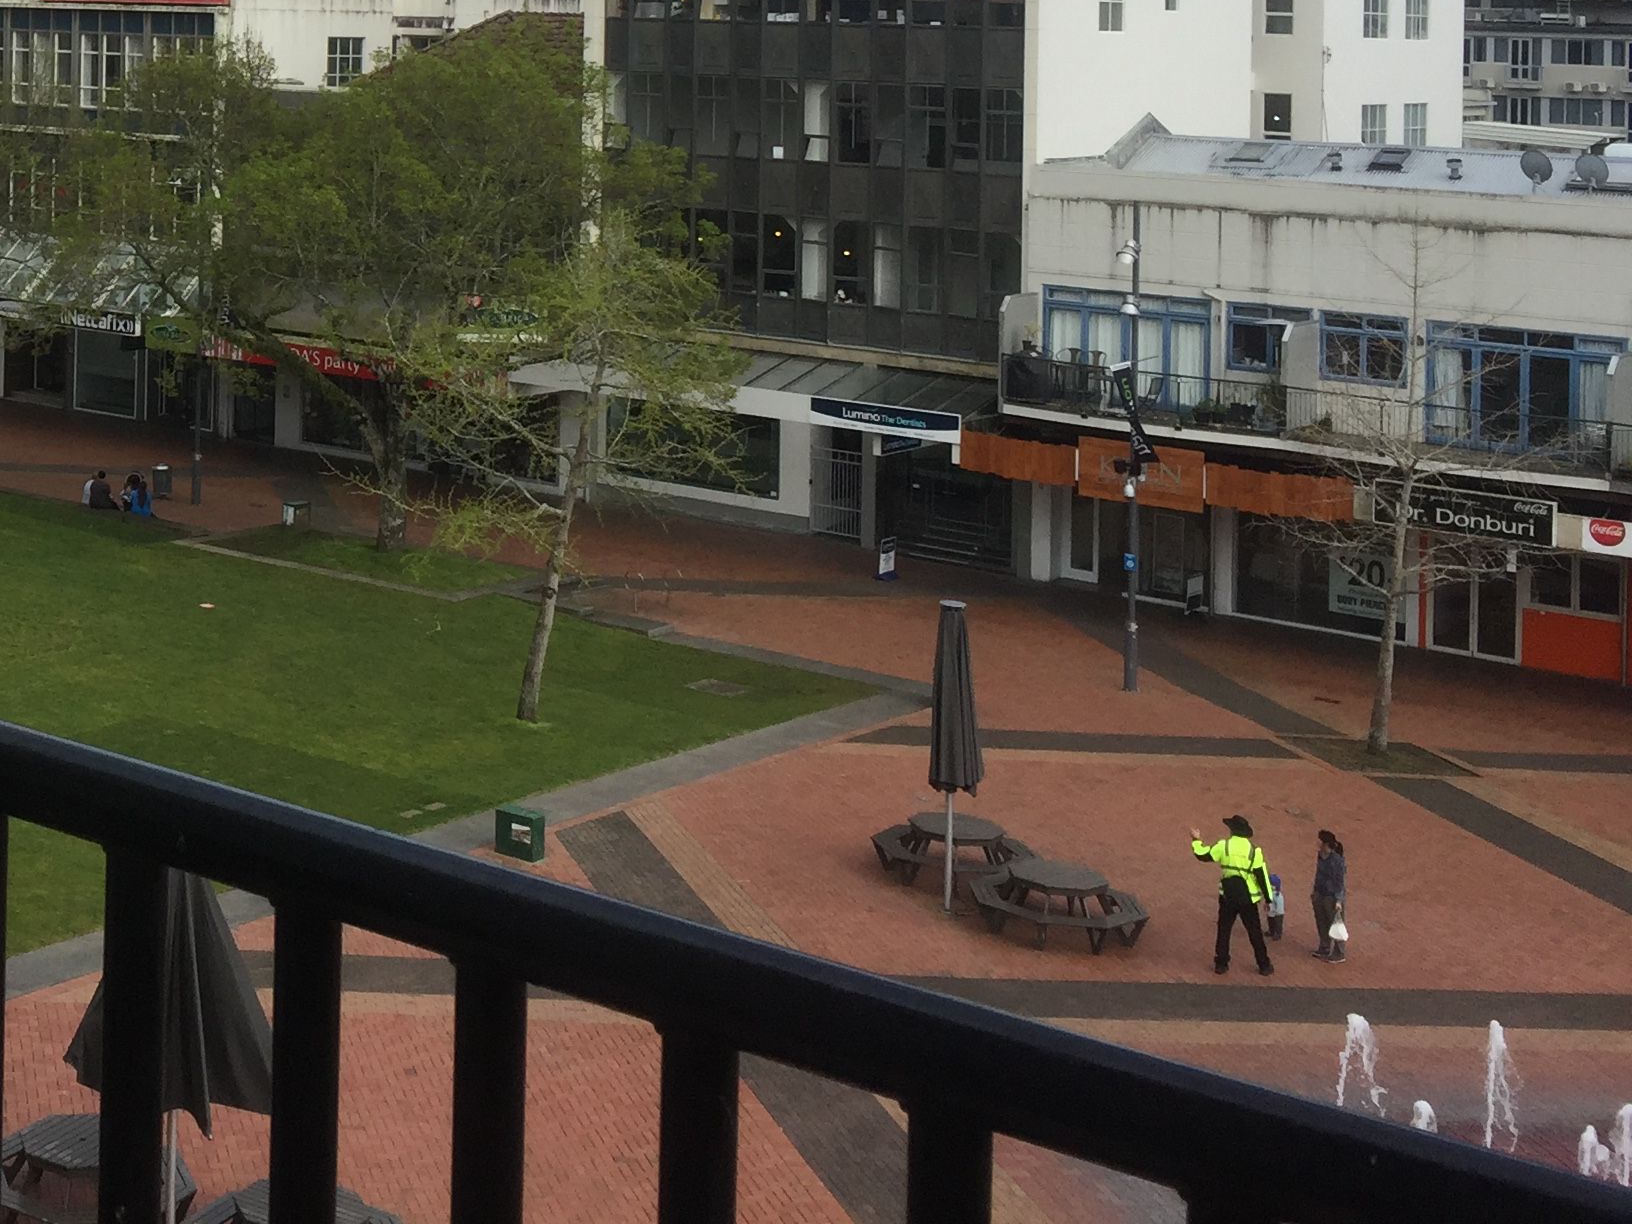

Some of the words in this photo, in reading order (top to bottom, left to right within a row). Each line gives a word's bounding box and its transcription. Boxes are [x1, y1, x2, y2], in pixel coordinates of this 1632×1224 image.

[324, 355, 360, 374] party
[842, 406, 881, 422] Lumino
[897, 416, 926, 429] Dentists
[1435, 507, 1535, 537] Donburi
